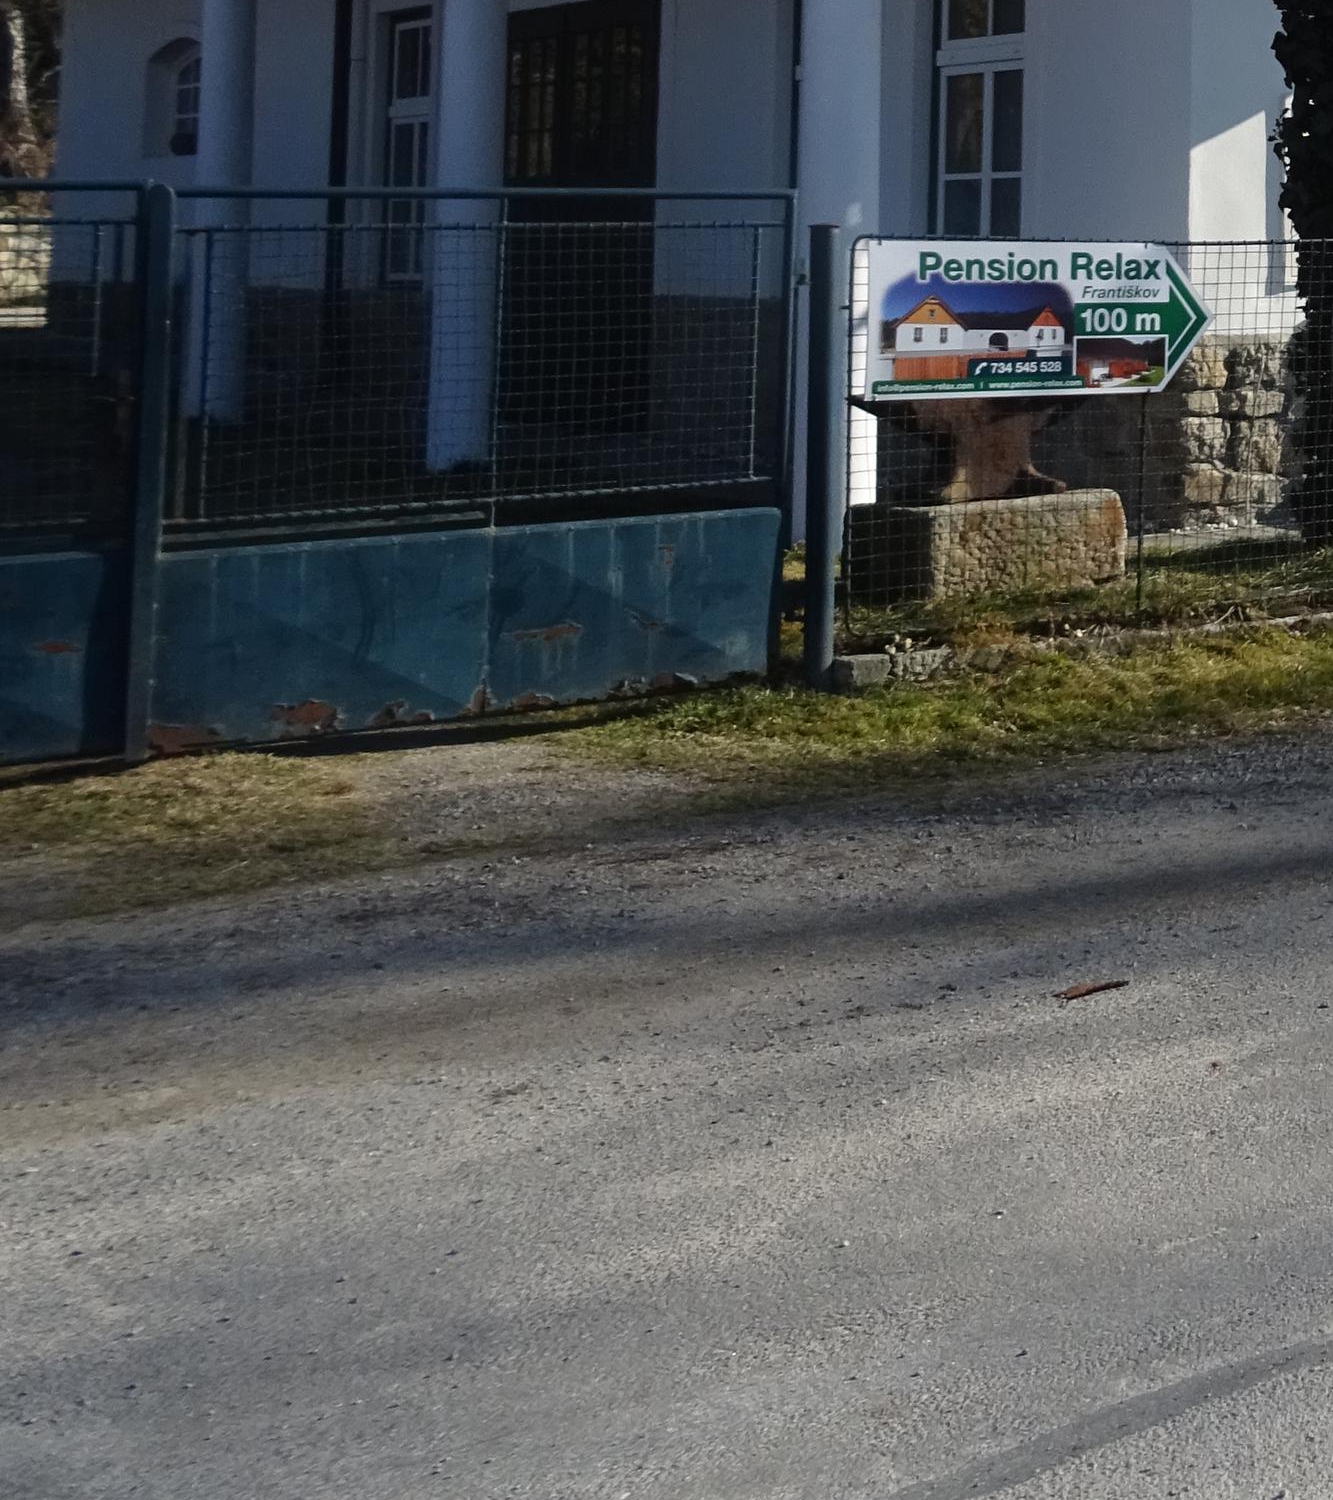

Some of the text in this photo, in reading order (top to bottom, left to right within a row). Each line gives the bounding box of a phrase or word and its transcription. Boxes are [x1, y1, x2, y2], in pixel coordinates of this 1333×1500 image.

[919, 251, 1161, 281] Pension Relax
[1081, 285, 1160, 299] Františkov
[1080, 307, 1161, 333] 100 m
[991, 361, 1062, 374] 734 545 528
[989, 379, 1082, 389] www.pension-relax.com
